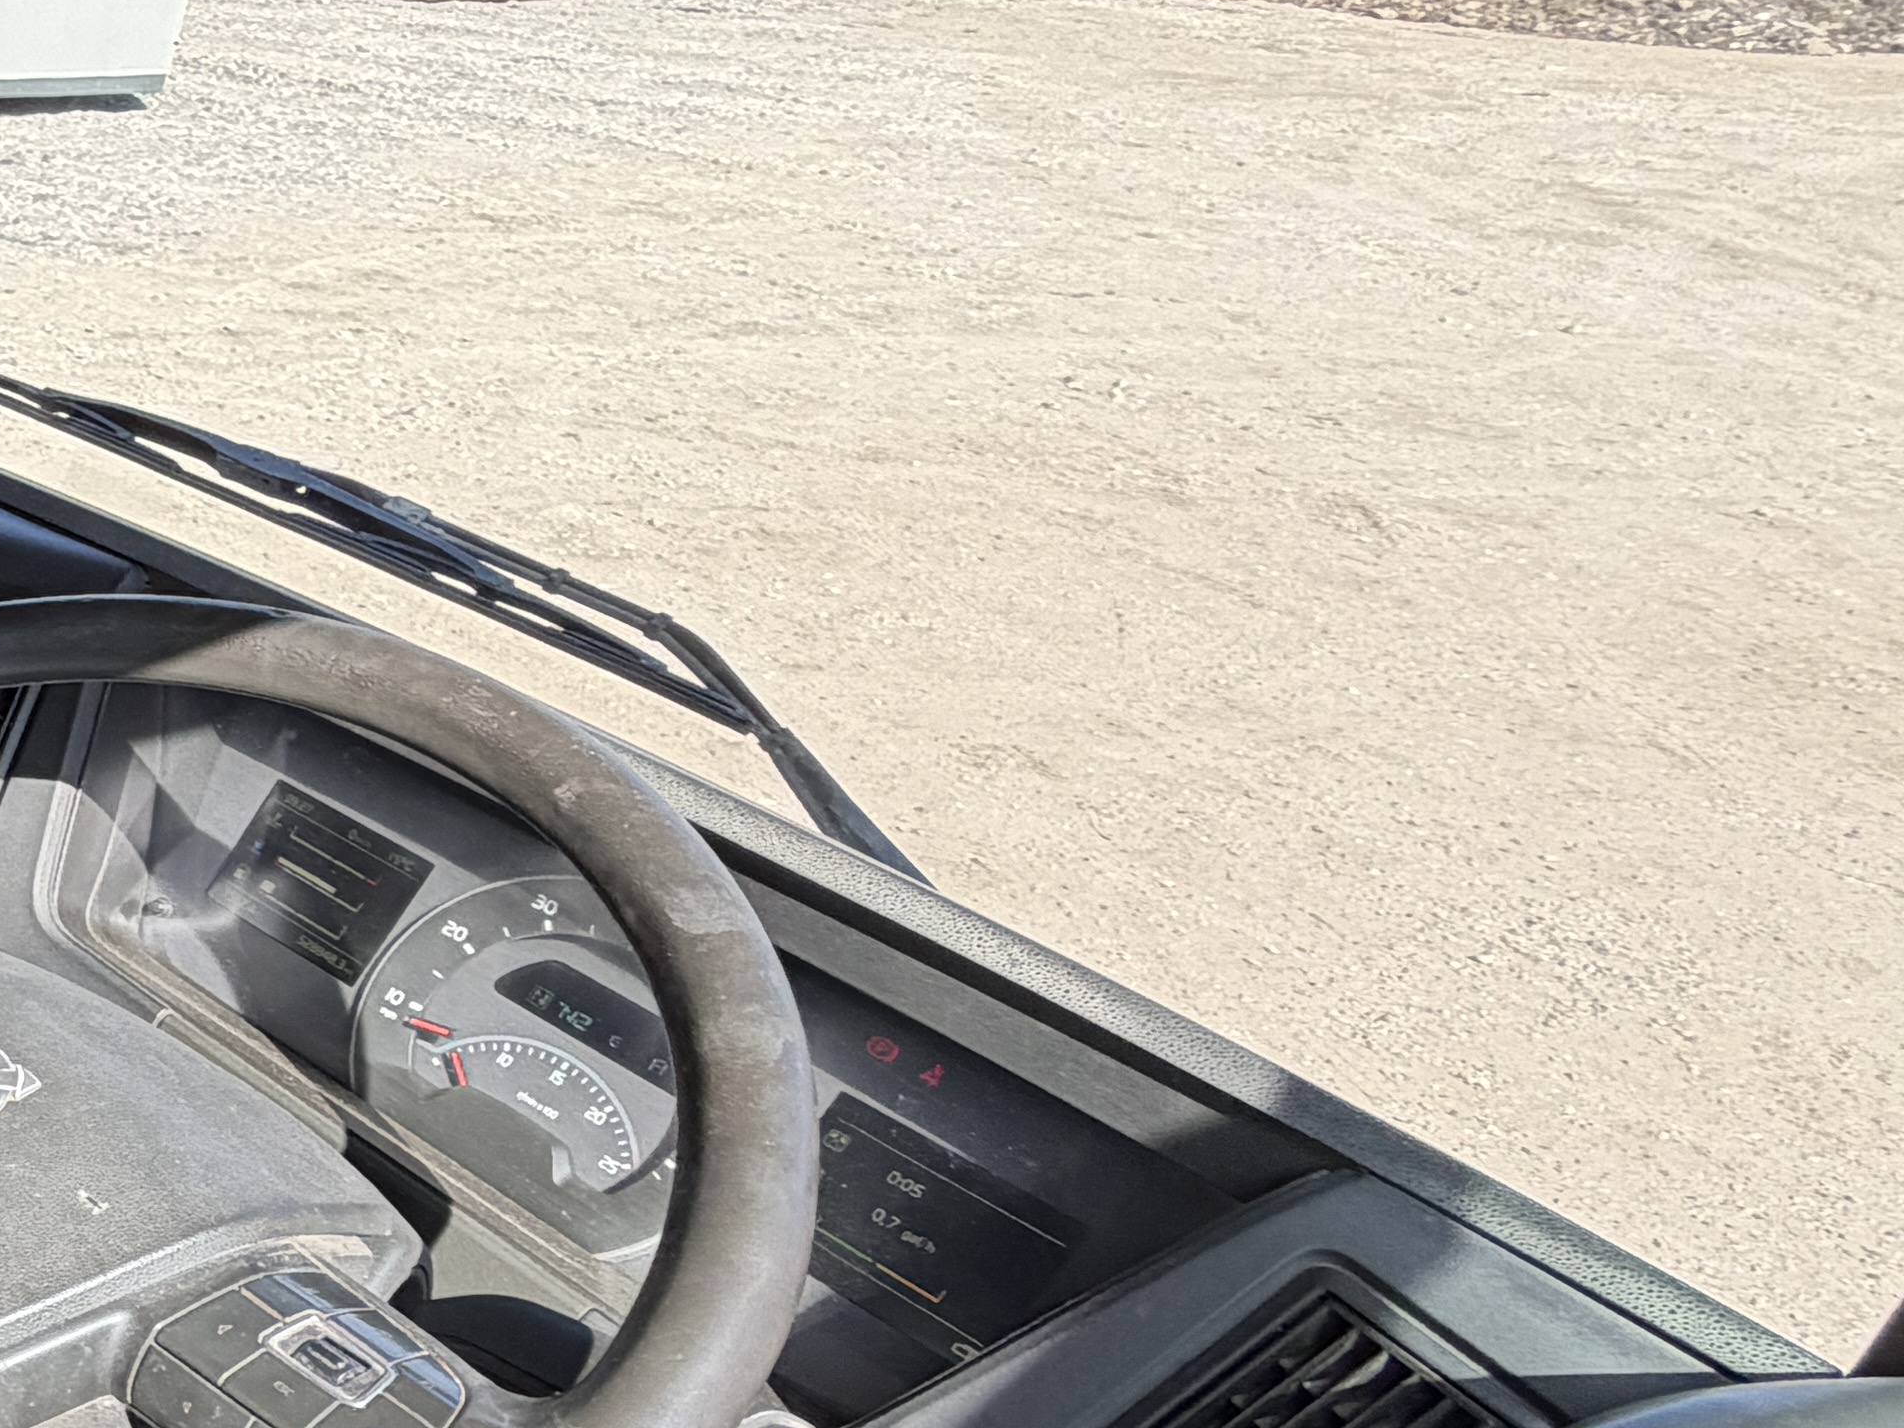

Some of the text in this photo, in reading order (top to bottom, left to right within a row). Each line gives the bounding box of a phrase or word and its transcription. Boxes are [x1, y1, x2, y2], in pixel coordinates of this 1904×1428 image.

[530, 894, 559, 916] 30
[441, 920, 469, 943] 20
[383, 988, 406, 1006] 10
[495, 1052, 514, 1068] 10
[548, 1069, 568, 1087] 15
[583, 1106, 608, 1126] 20
[598, 1154, 621, 1175] 25
[885, 1170, 927, 1199] 0:05
[871, 1207, 902, 1229] 0.7
